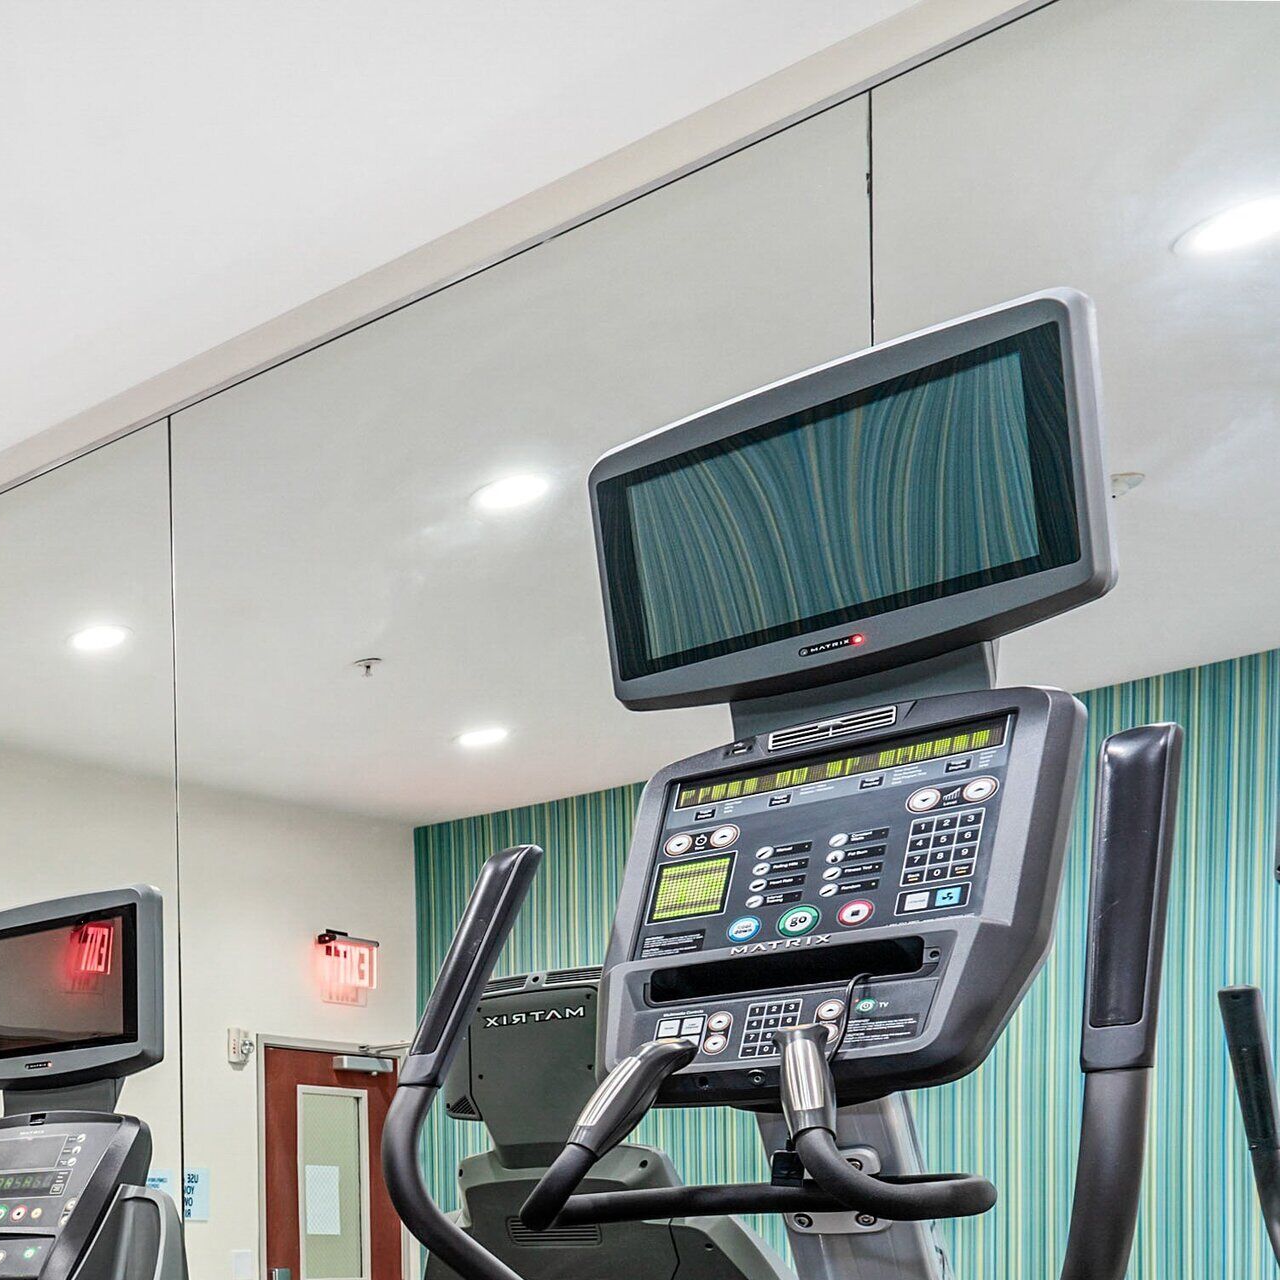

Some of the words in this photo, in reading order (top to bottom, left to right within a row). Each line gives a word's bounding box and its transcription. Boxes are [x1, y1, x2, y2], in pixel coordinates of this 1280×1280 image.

[811, 639, 849, 652] MATRIX
[790, 916, 807, 927] go
[730, 935, 831, 955] MATRIX
